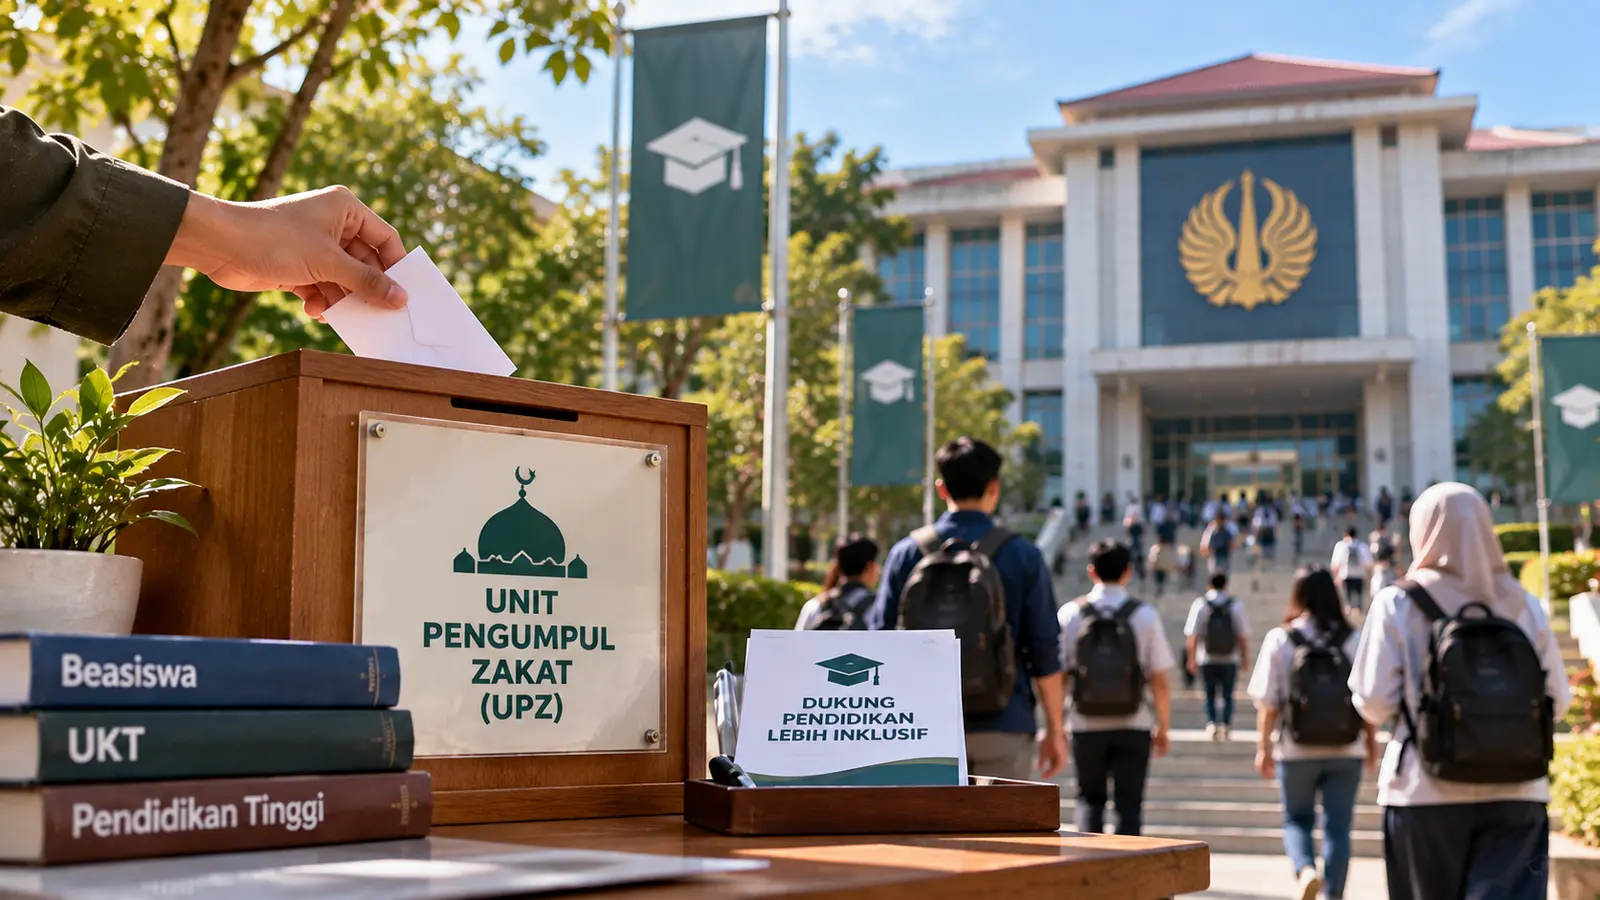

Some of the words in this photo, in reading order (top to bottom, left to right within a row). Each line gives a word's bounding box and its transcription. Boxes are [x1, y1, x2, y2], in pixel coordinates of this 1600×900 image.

[485, 587, 559, 615] UNIT
[423, 621, 616, 651] PENGUMPUL
[61, 653, 198, 689] Beasiswa
[471, 659, 573, 685] ZAKAT
[480, 692, 564, 725] (UPZ)
[802, 696, 895, 710] DUKUNG
[782, 712, 914, 726] PENDIDIKAN
[68, 726, 146, 764] UKT
[767, 728, 827, 742] LEBIH
[833, 727, 929, 742] INKLUSIF
[72, 796, 238, 839] Pendidikan
[244, 791, 325, 831] Tinggi
